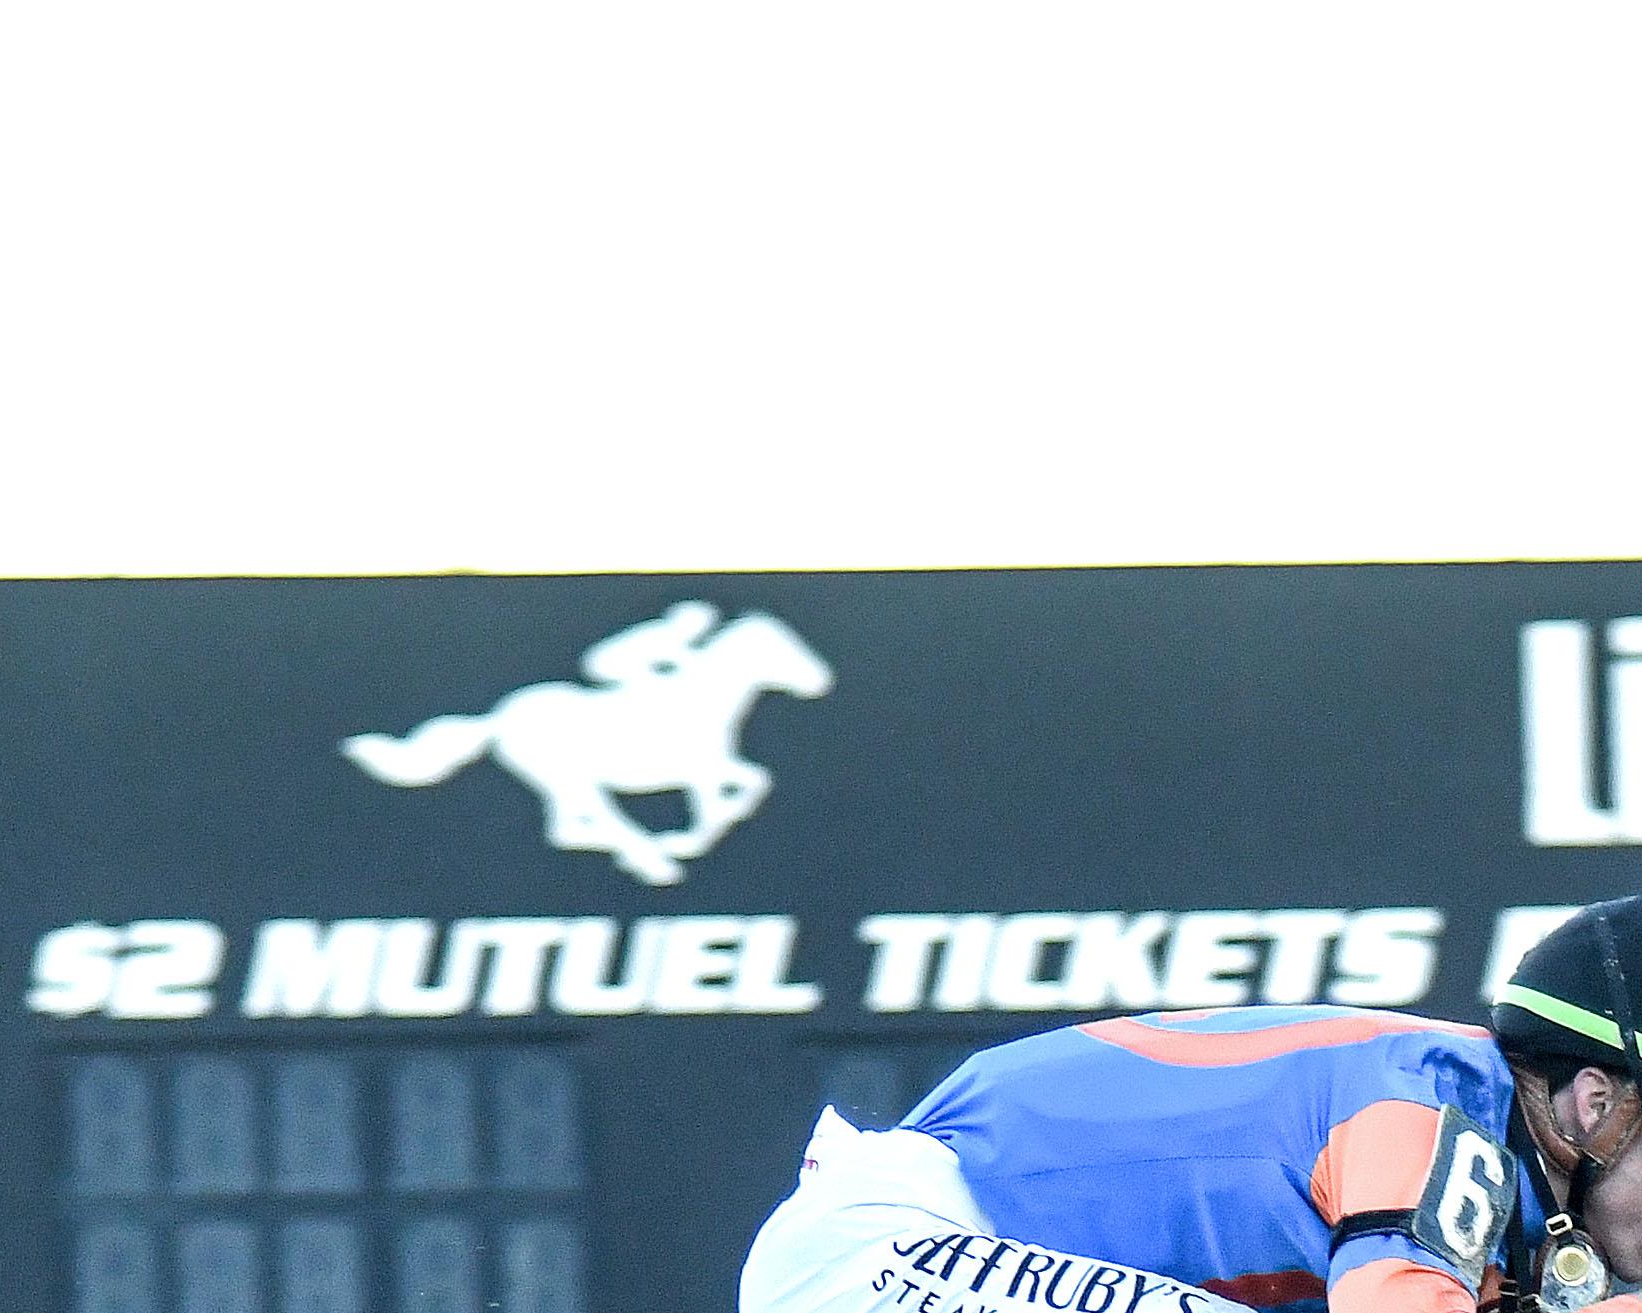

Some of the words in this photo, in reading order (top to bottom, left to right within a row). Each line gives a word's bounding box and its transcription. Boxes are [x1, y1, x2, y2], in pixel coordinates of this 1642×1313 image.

[241, 914, 823, 1019] MUTUEL
[857, 906, 1445, 1014] TICKETS
[1436, 1128, 1506, 1260] 6
